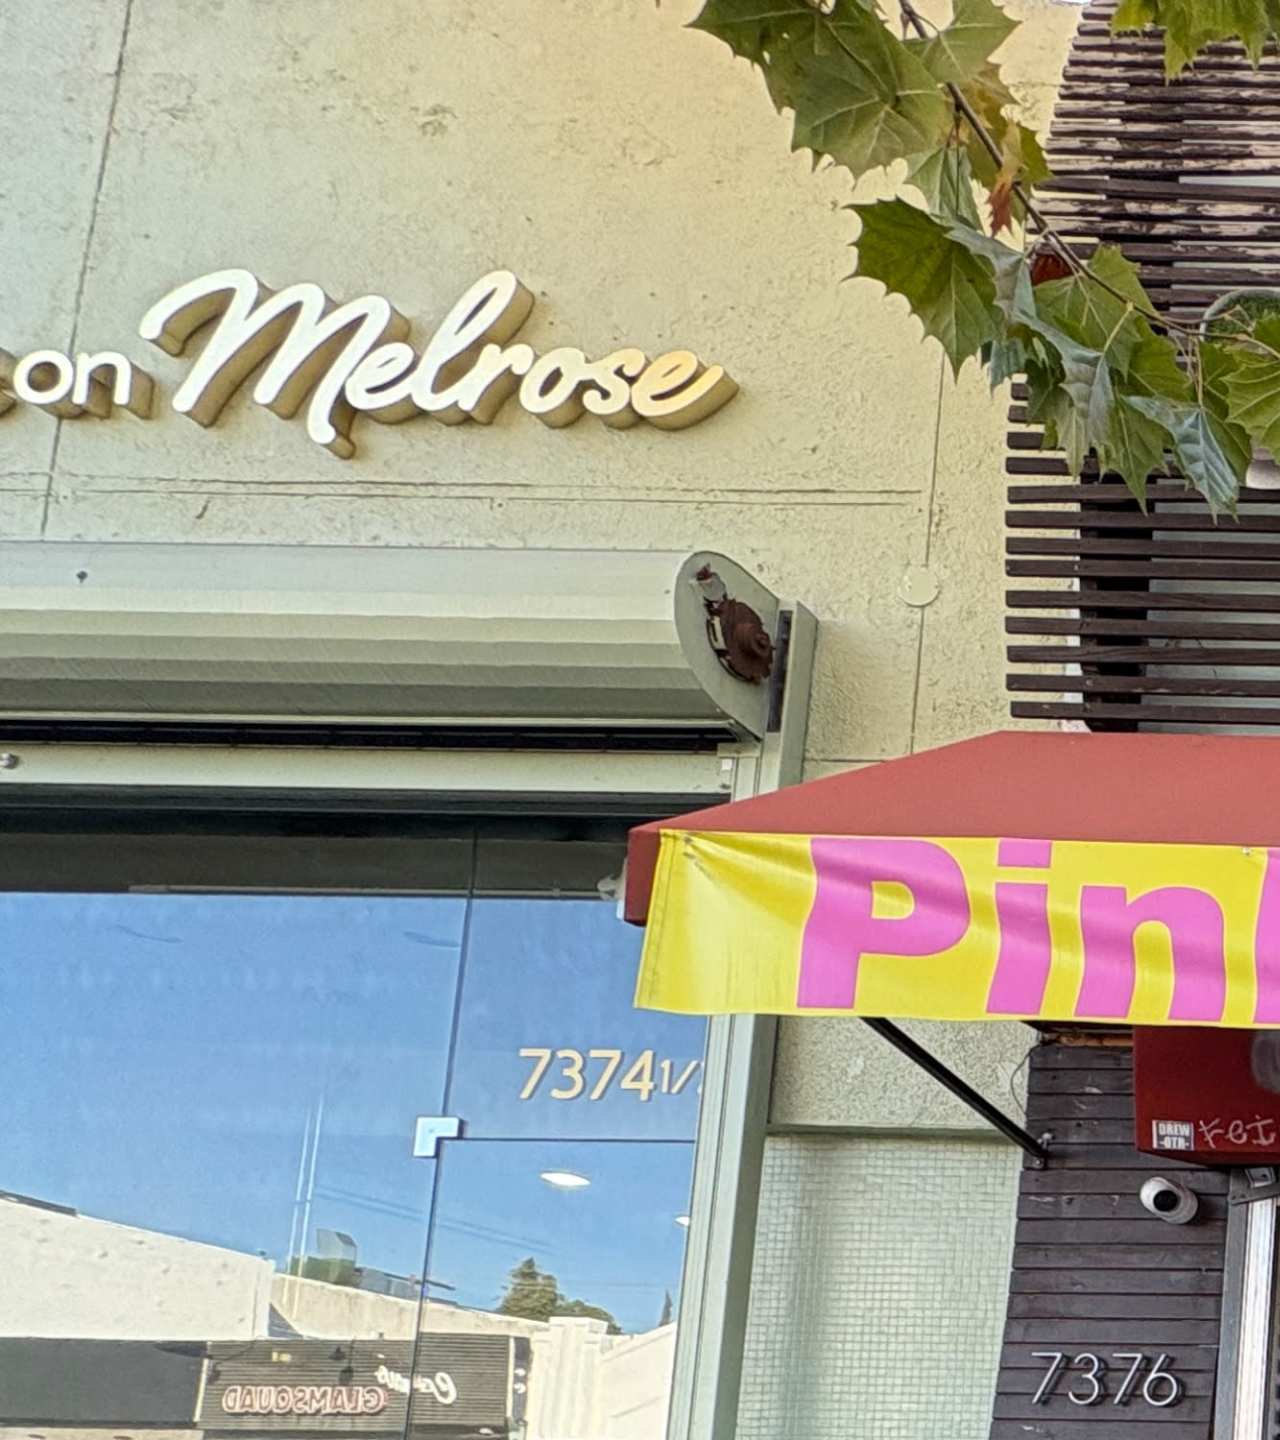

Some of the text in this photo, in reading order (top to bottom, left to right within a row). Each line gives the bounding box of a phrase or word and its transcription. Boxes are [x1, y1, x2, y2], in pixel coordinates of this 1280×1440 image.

[13, 268, 732, 450] on Melrose
[518, 1047, 706, 1101] 7374 1/
[1032, 1351, 1178, 1406] 7376
